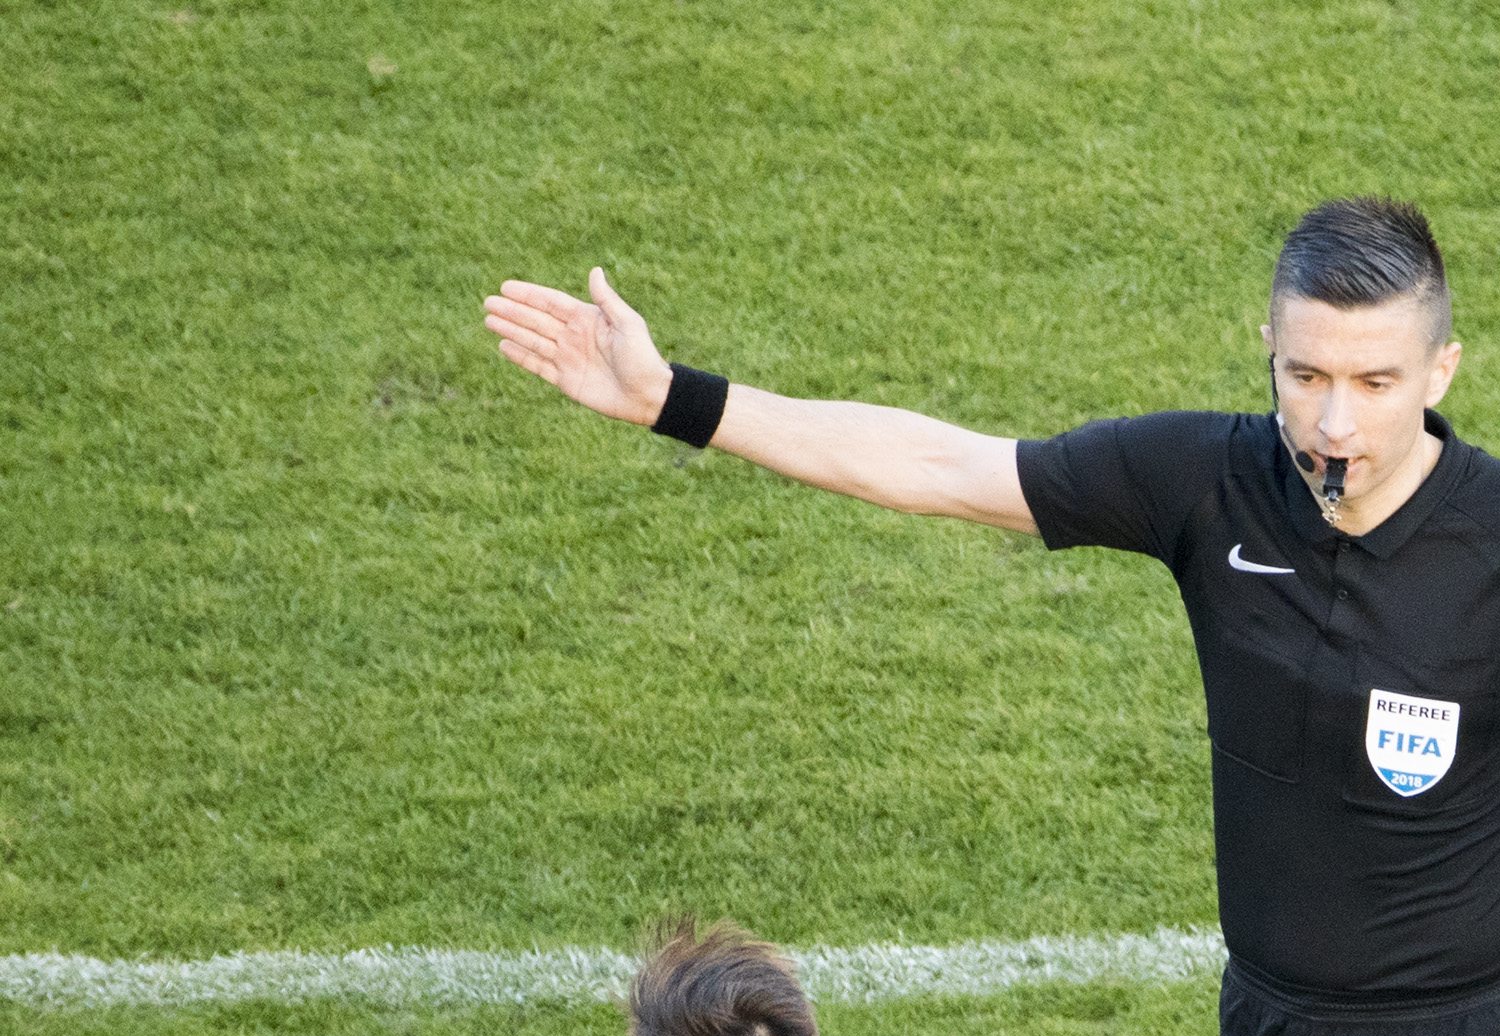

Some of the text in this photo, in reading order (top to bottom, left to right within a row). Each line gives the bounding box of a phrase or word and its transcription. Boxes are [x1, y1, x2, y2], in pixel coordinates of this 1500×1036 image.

[1376, 699, 1451, 720] REFEREE
[1377, 729, 1442, 758] FIFA
[1391, 773, 1422, 787] 2018
